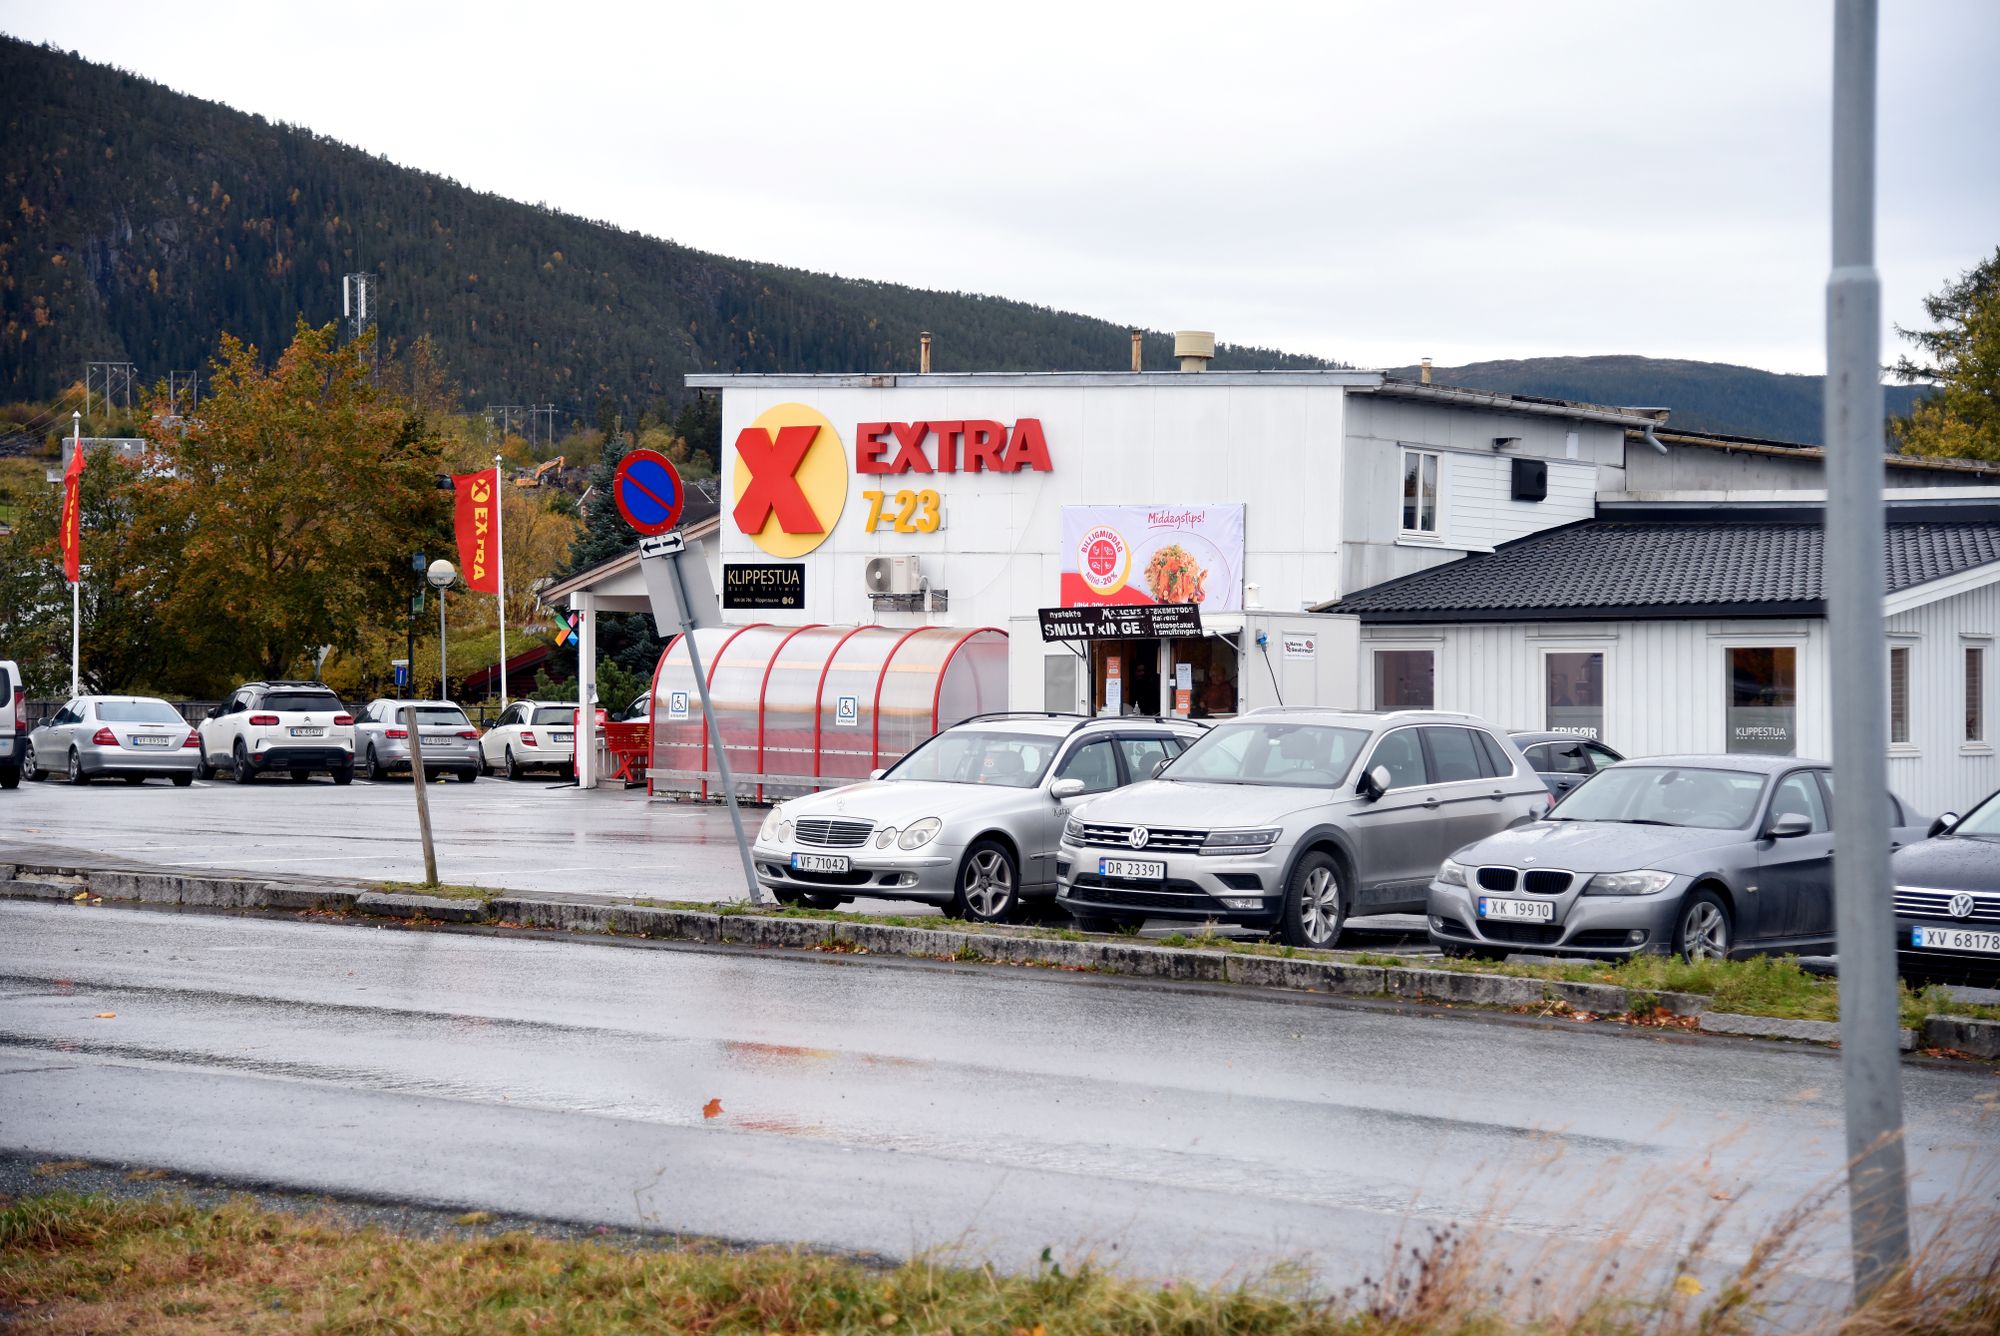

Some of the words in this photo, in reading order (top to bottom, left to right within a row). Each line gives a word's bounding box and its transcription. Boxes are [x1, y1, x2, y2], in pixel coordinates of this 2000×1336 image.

[856, 418, 1053, 474] EXTRA
[863, 489, 940, 534] 7-23
[1147, 510, 1205, 529] Middagstips!
[1081, 530, 1123, 554] BILLIGMIDDAG
[728, 569, 800, 584] KLIPPESTUA
[1085, 571, 1100, 585] Alltid
[1100, 573, 1118, 585] -20%
[1735, 727, 1787, 736] KLIPPESTUA
[801, 856, 812, 867] VF
[815, 857, 844, 870] 71042
[1108, 862, 1122, 874] DR
[1127, 863, 1160, 877] 23391
[1492, 901, 1507, 914] XK
[1514, 903, 1549, 917] 19910
[1927, 931, 1947, 945] XV
[1954, 933, 2000, 950] 68178
